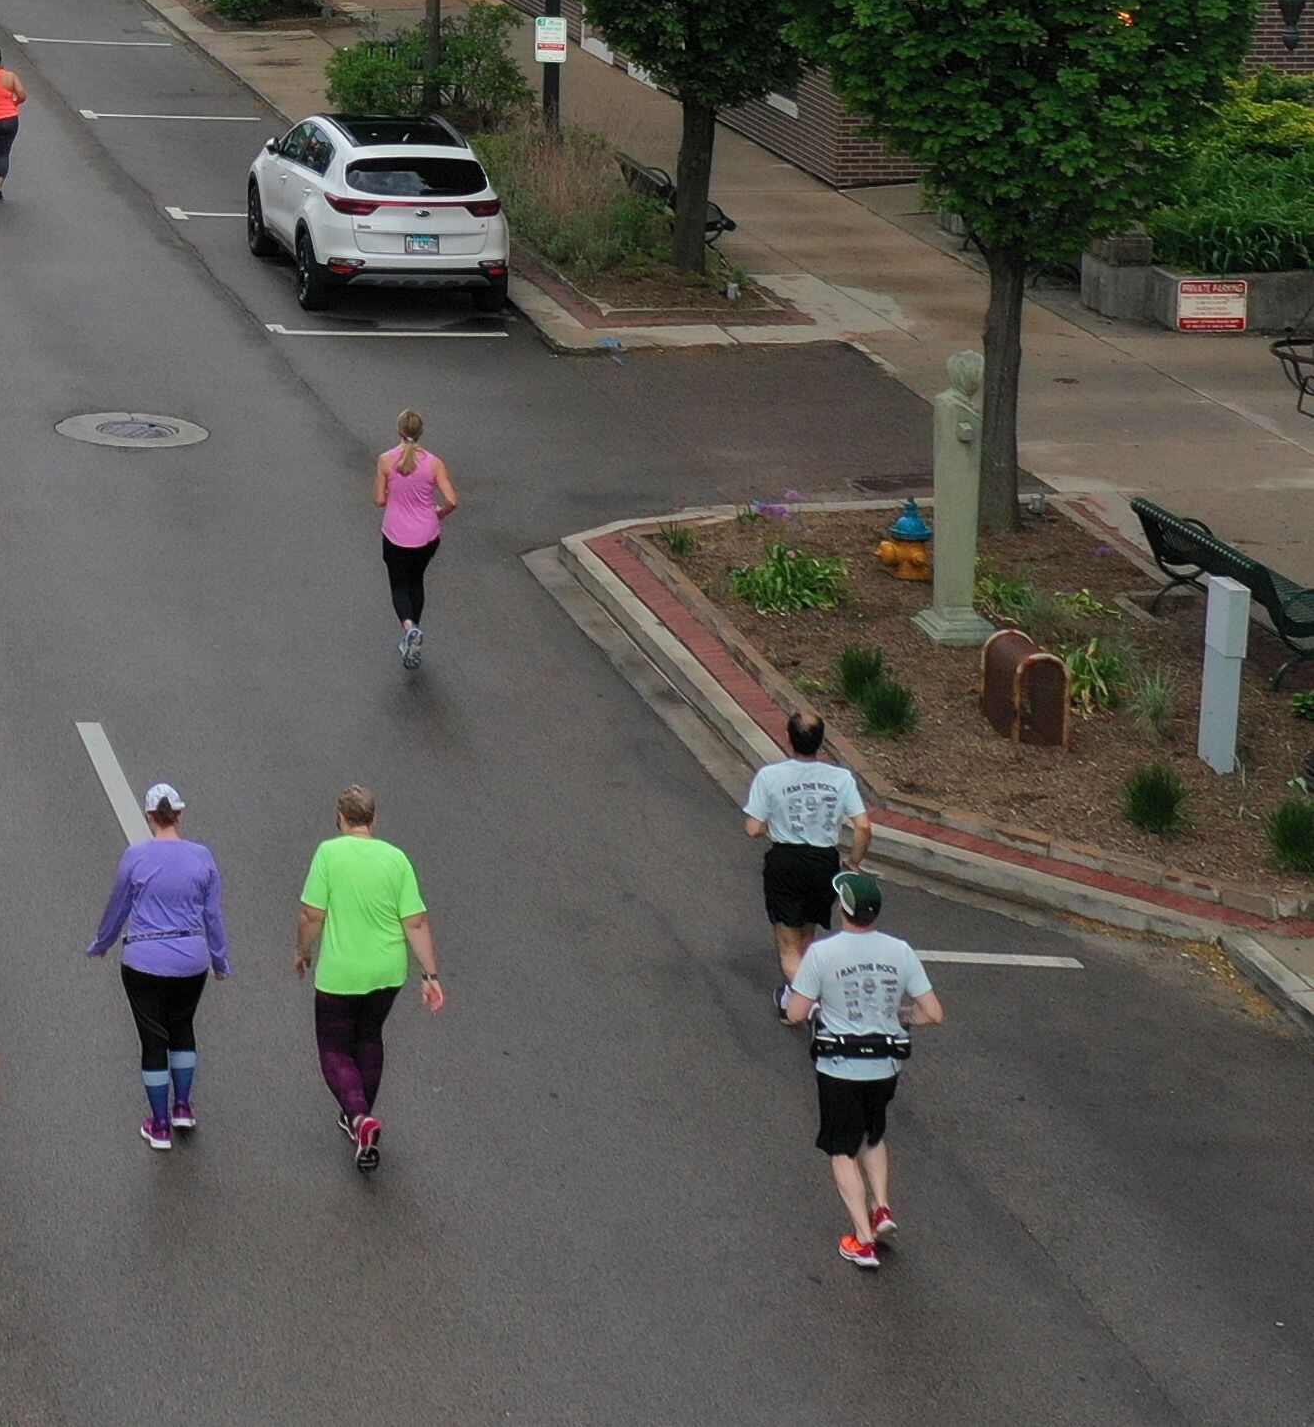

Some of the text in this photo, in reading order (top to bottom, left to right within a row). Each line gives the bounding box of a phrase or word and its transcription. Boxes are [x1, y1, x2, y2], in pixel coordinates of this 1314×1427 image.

[1181, 283, 1244, 293] PRIVATE PARKING
[786, 785, 801, 793] RAN
[817, 783, 838, 793] ROCK
[840, 965, 857, 977] RAN
[858, 963, 874, 972] THE
[876, 963, 898, 975] ROCK
